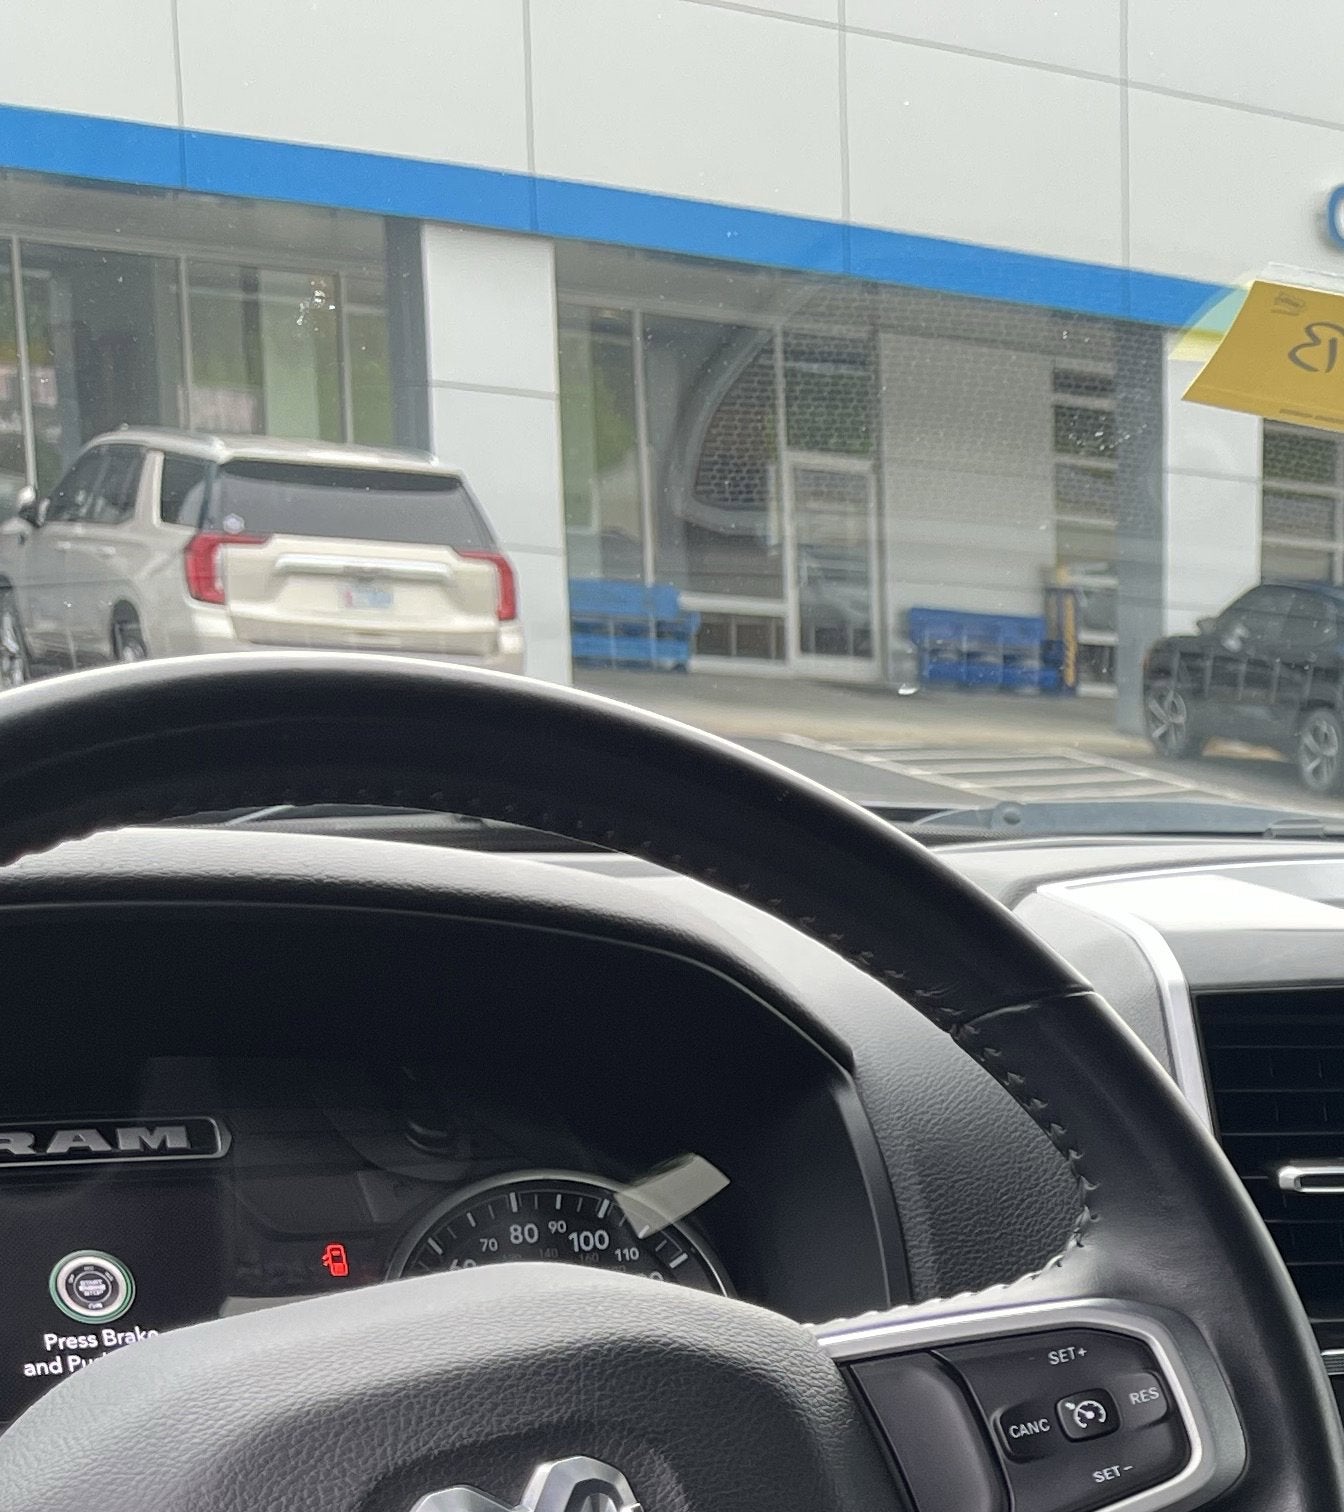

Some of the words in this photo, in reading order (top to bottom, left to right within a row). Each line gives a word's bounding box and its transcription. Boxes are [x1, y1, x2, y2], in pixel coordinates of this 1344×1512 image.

[0, 1126, 191, 1155] RAM
[509, 1223, 539, 1245] 80
[548, 1220, 567, 1234] 90
[479, 1237, 498, 1253] 70
[568, 1229, 610, 1252] 100
[614, 1247, 640, 1262] 110
[44, 1333, 98, 1351] Press
[23, 1358, 63, 1377] and
[1129, 1387, 1160, 1405] RES
[1009, 1418, 1051, 1438] CANC
